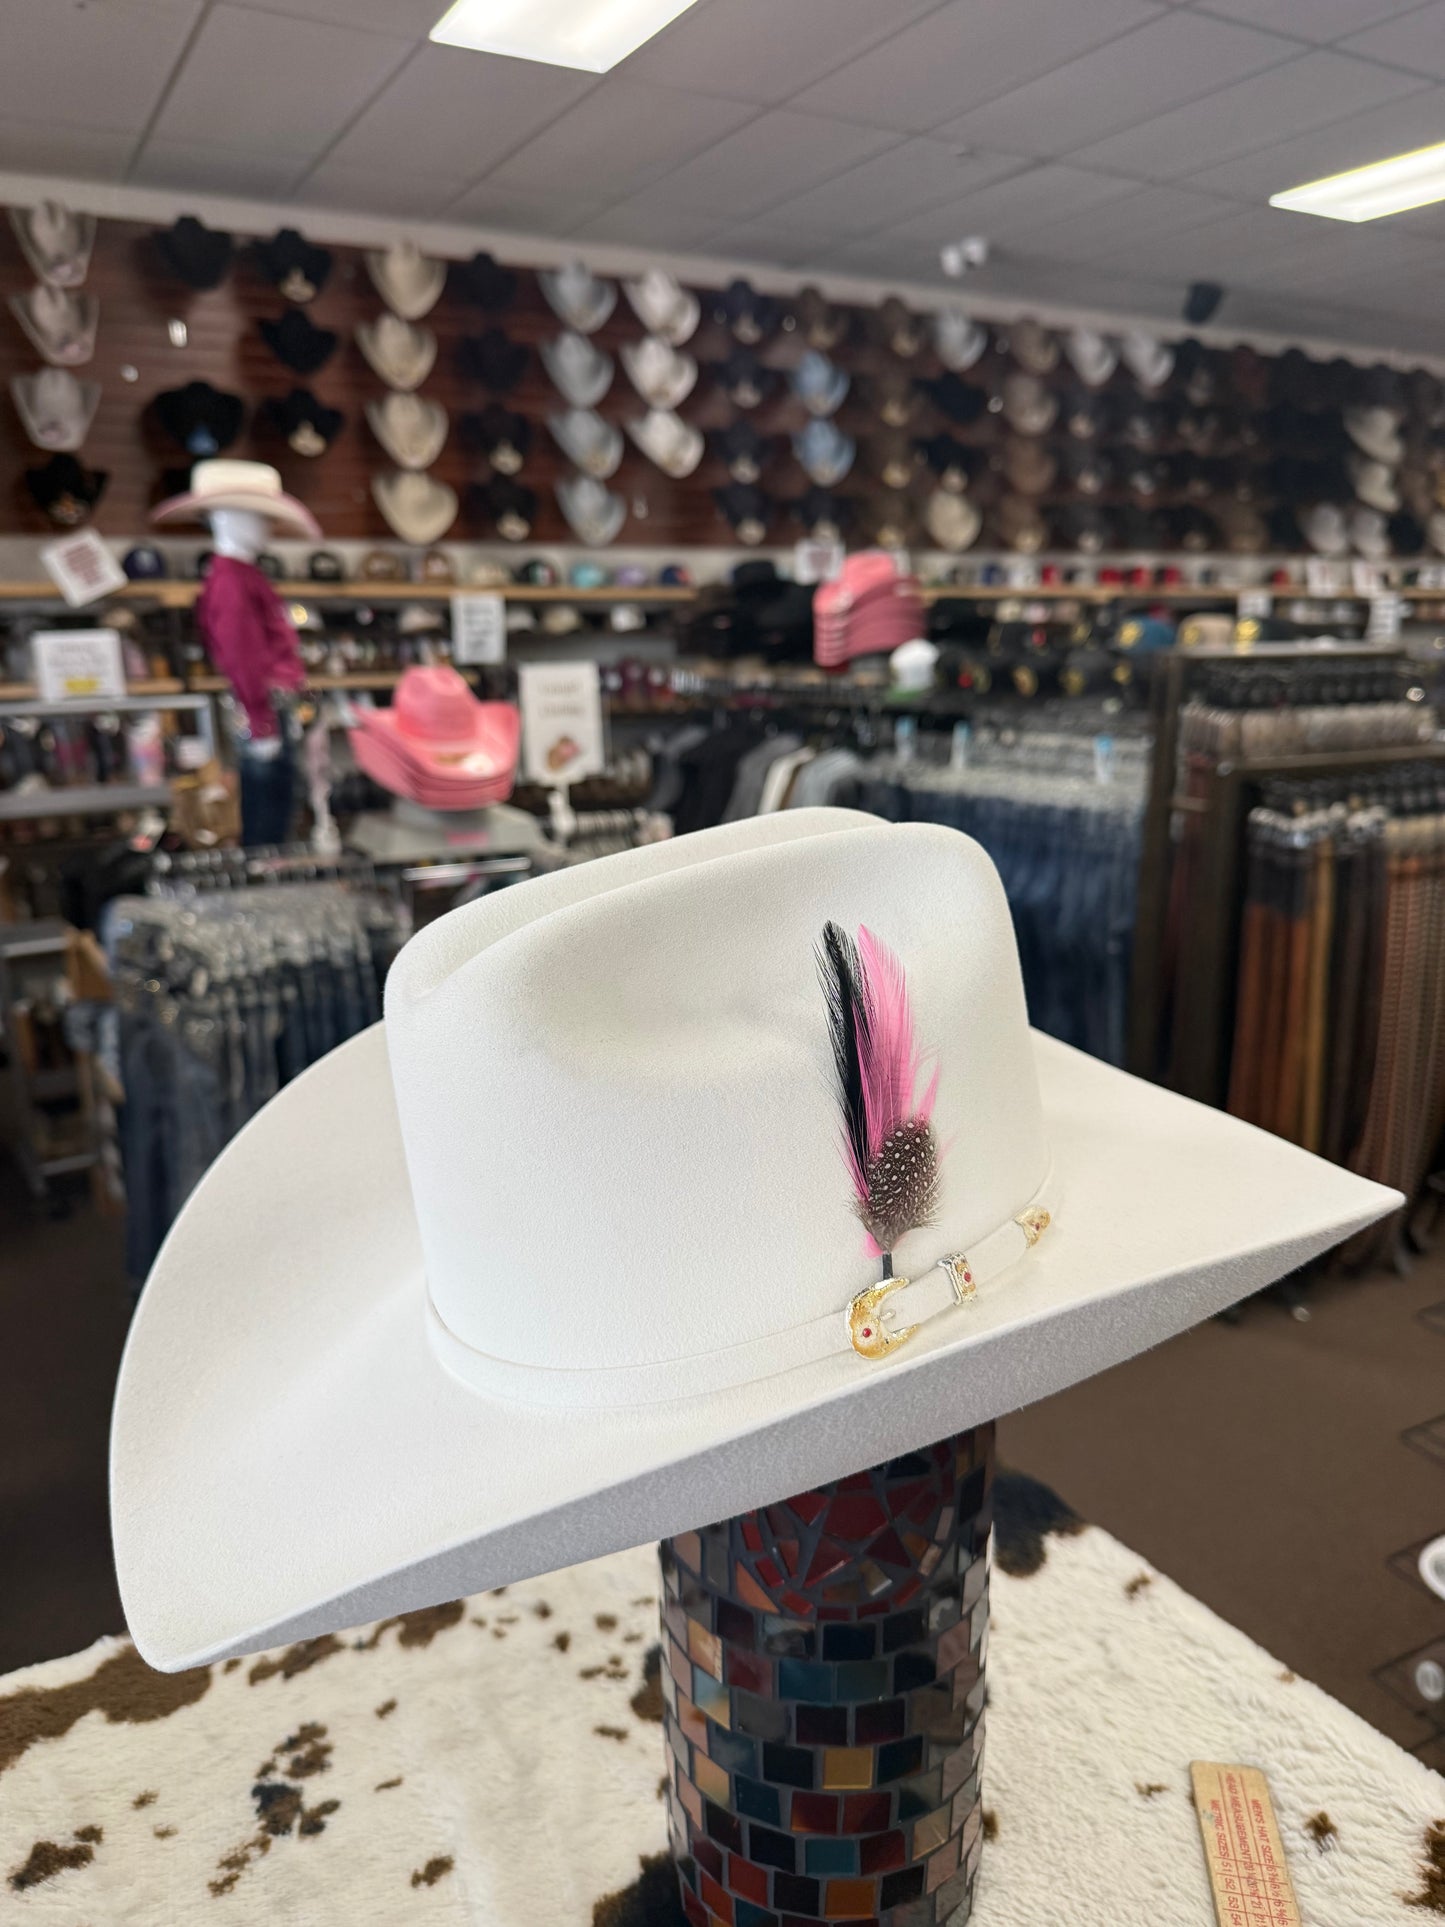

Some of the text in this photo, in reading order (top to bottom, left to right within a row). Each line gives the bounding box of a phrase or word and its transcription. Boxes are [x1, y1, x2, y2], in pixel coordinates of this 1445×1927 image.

[1227, 1773, 1238, 1794] HEAD
[1258, 1826, 1269, 1843] HAT
[1211, 1800, 1242, 1926] METRIC SIZES 51 52 53 54
[1262, 1845, 1274, 1864] SIZE
